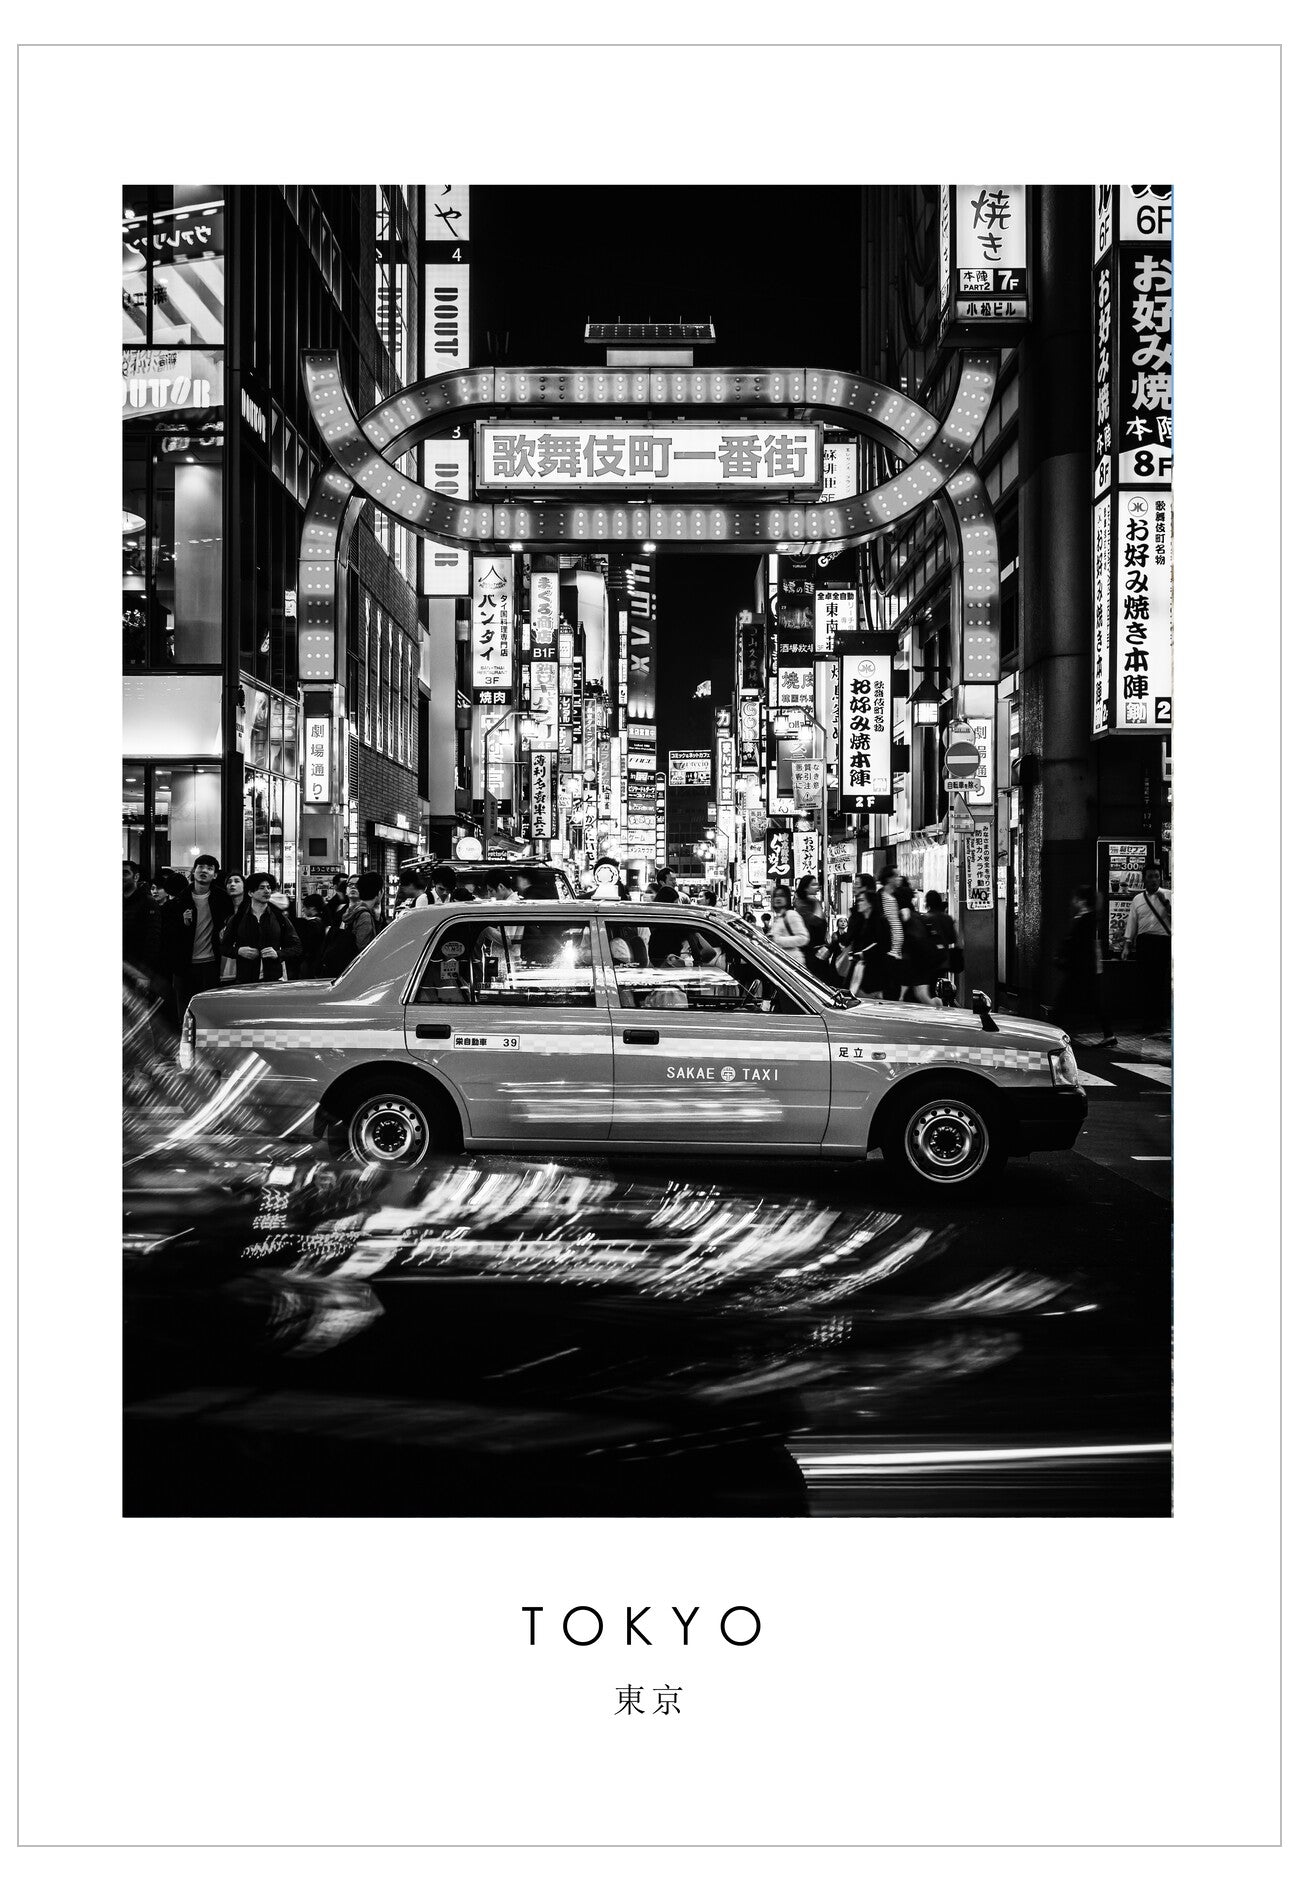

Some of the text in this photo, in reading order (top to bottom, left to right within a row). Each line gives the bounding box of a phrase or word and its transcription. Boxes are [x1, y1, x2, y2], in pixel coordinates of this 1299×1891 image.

[434, 185, 462, 238] や
[998, 270, 1019, 291] 7F
[966, 302, 1016, 316] 小松ビル
[492, 433, 808, 478] 歌舞伎町一番街
[1154, 500, 1166, 565] 歌舞伎町名物
[1123, 517, 1150, 700] お好み焼き本陣
[478, 594, 497, 661] バンタイ
[533, 648, 556, 658] B1F
[485, 676, 500, 685] 3F
[480, 691, 506, 704] 焼肉
[310, 724, 325, 796] 劇場通り
[947, 781, 979, 790] 自転車を除く
[855, 796, 876, 808] 2F
[456, 1037, 517, 1047] 栄自動車 39
[838, 1047, 864, 1058] 足立
[666, 1066, 778, 1081] SAKAE TAXI
